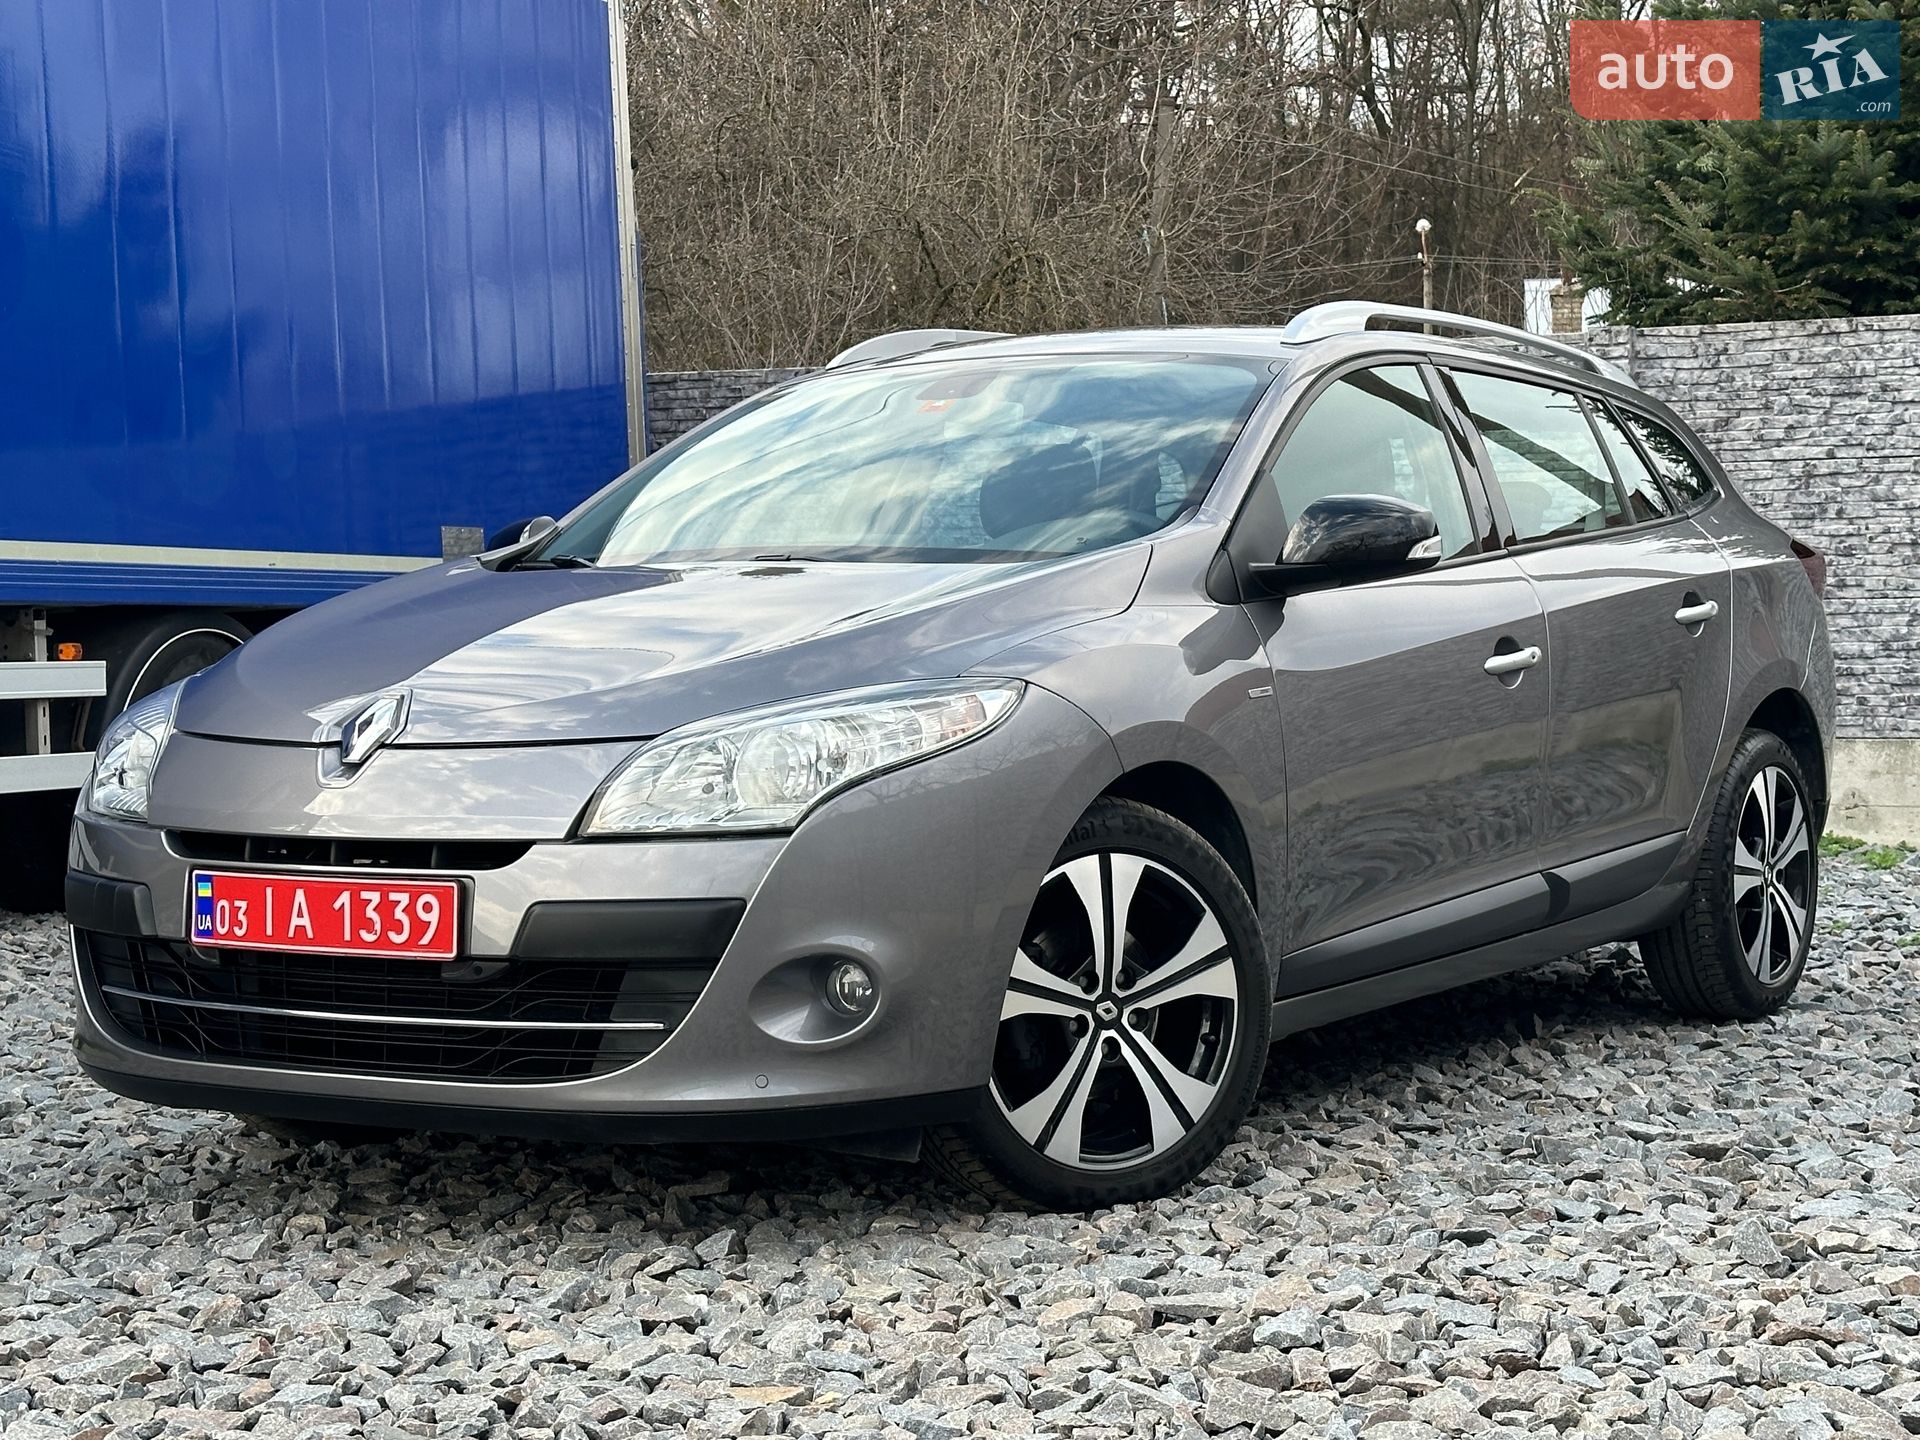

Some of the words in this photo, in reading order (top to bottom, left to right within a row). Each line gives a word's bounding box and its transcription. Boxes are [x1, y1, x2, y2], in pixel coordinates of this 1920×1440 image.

[197, 914, 212, 931] UA
[216, 899, 249, 937] 03
[332, 890, 441, 946] 1339
